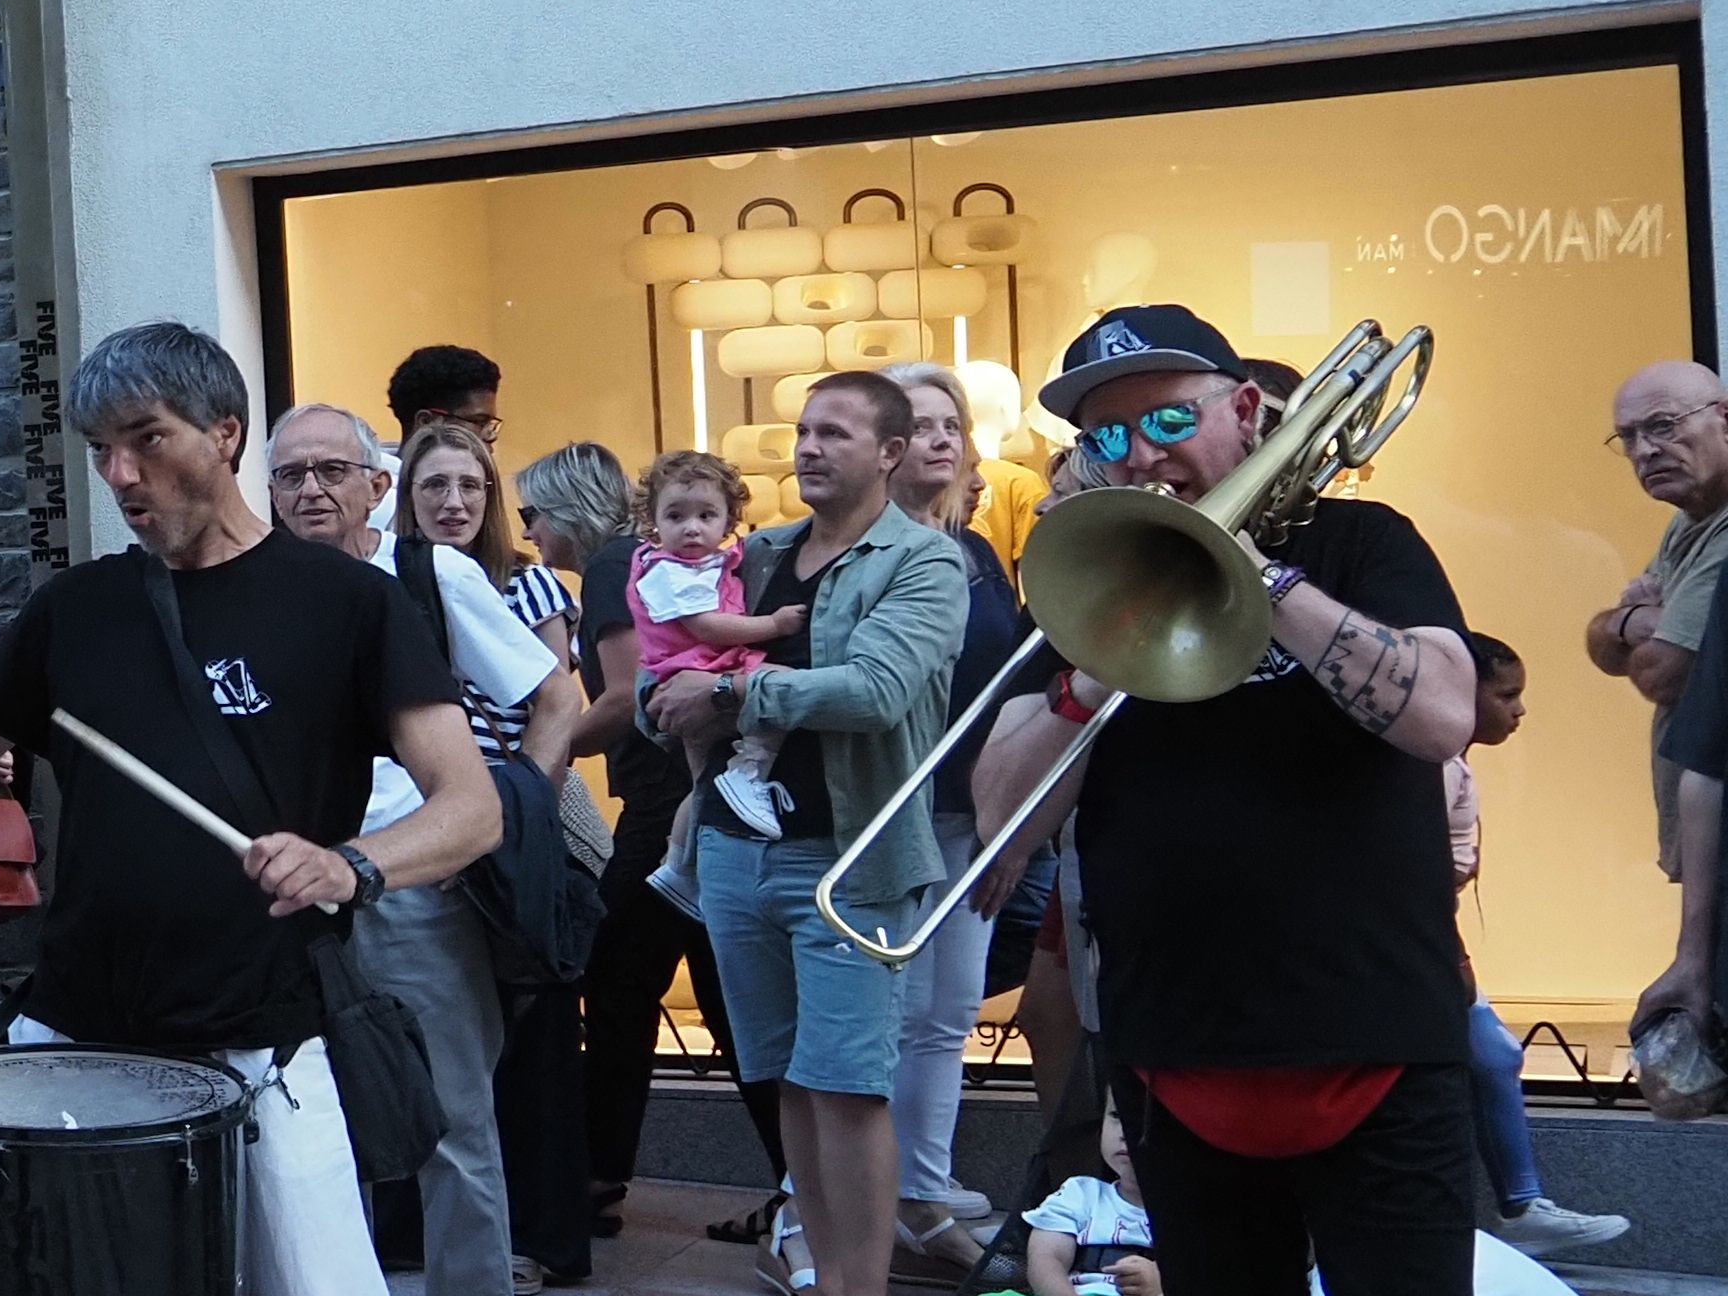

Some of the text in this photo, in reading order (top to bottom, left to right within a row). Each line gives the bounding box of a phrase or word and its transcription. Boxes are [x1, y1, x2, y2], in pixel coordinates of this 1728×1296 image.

[35, 300, 58, 357] FIVE
[19, 339, 40, 397] FIVE
[40, 380, 62, 435] FIVE
[23, 424, 45, 481] FIVE
[46, 464, 67, 521] FIVE
[28, 507, 51, 563] FIVE
[50, 547, 71, 569] FI
